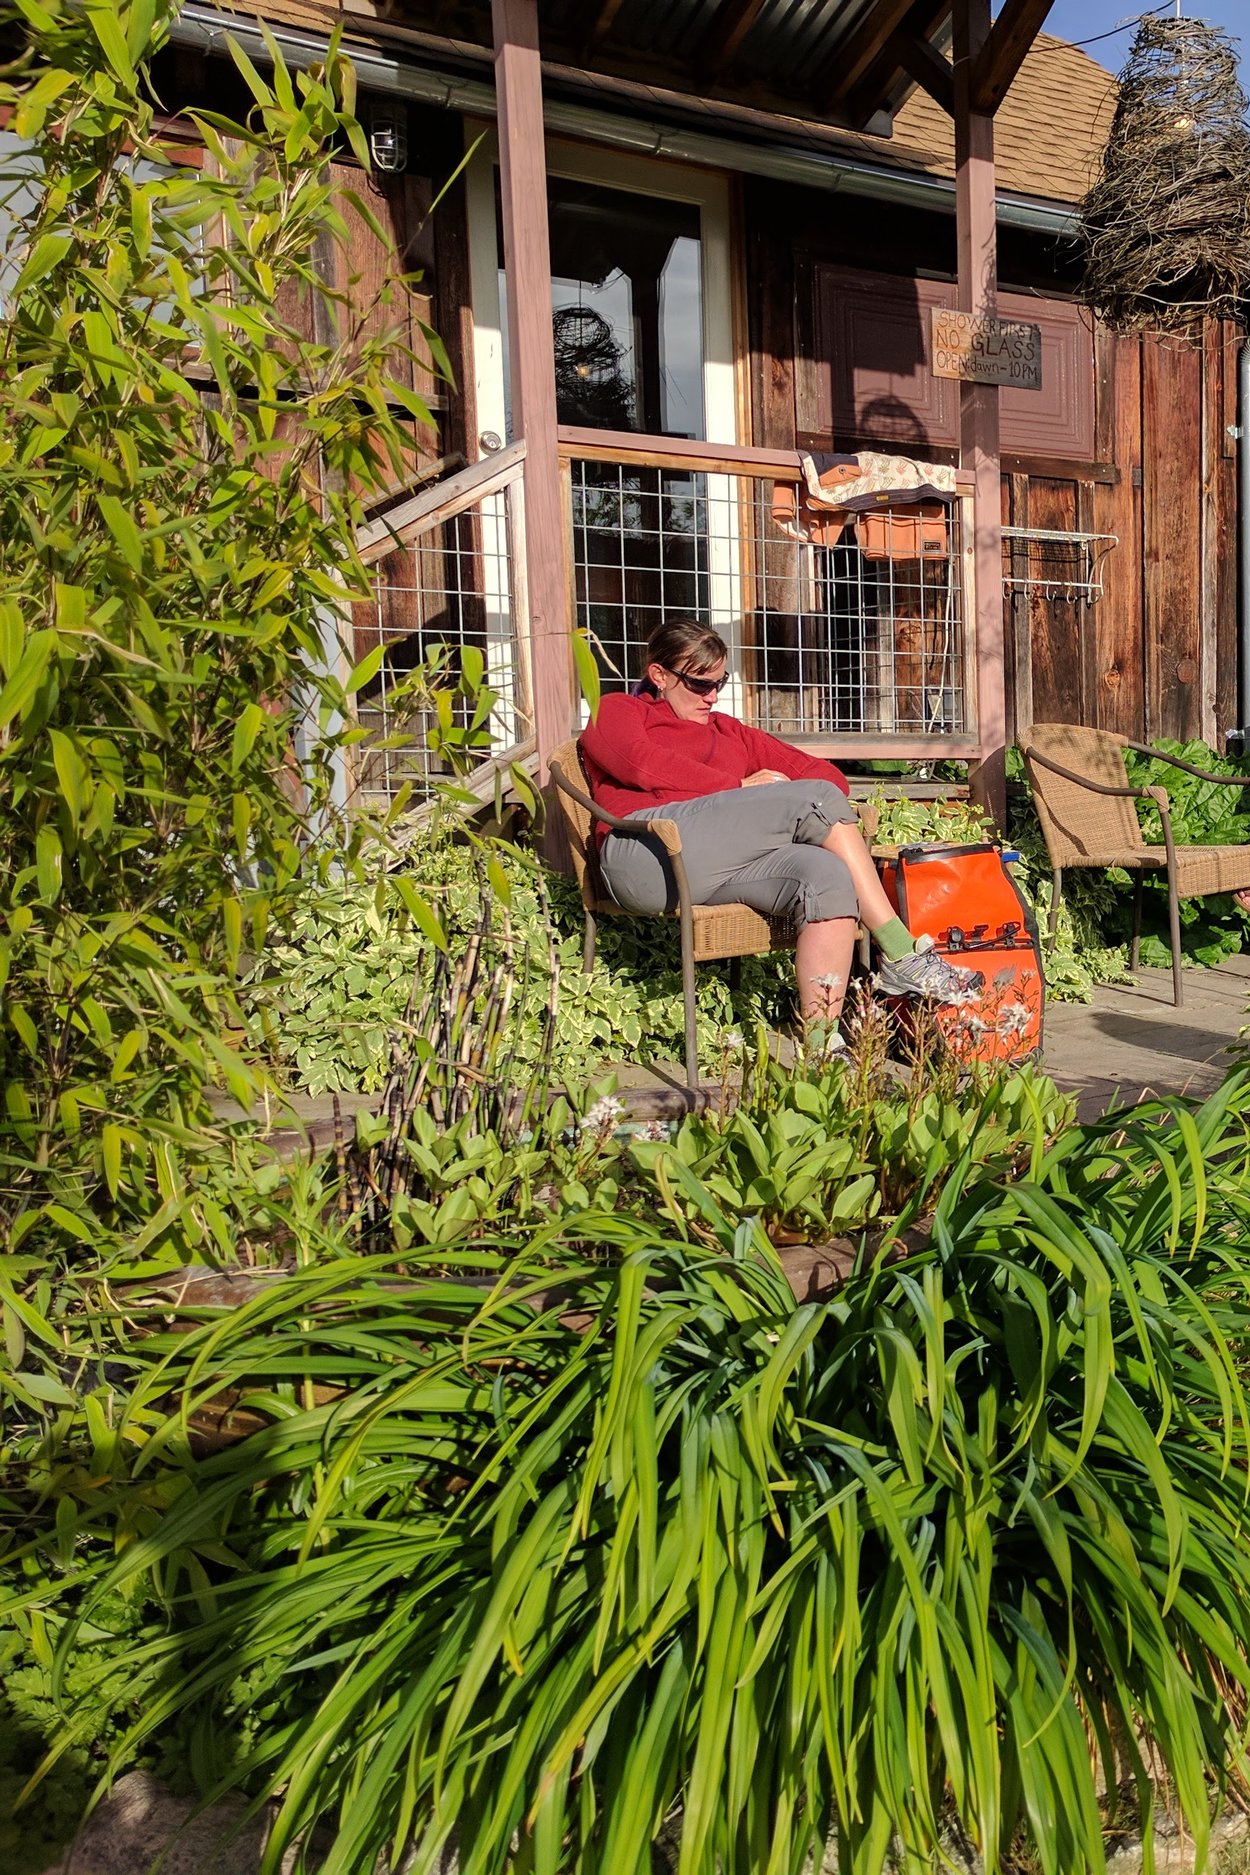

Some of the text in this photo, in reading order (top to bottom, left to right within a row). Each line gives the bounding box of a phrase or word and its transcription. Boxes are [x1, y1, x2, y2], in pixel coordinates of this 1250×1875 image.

[938, 311, 997, 337] SHOWER
[936, 329, 1034, 361] NO GLASS
